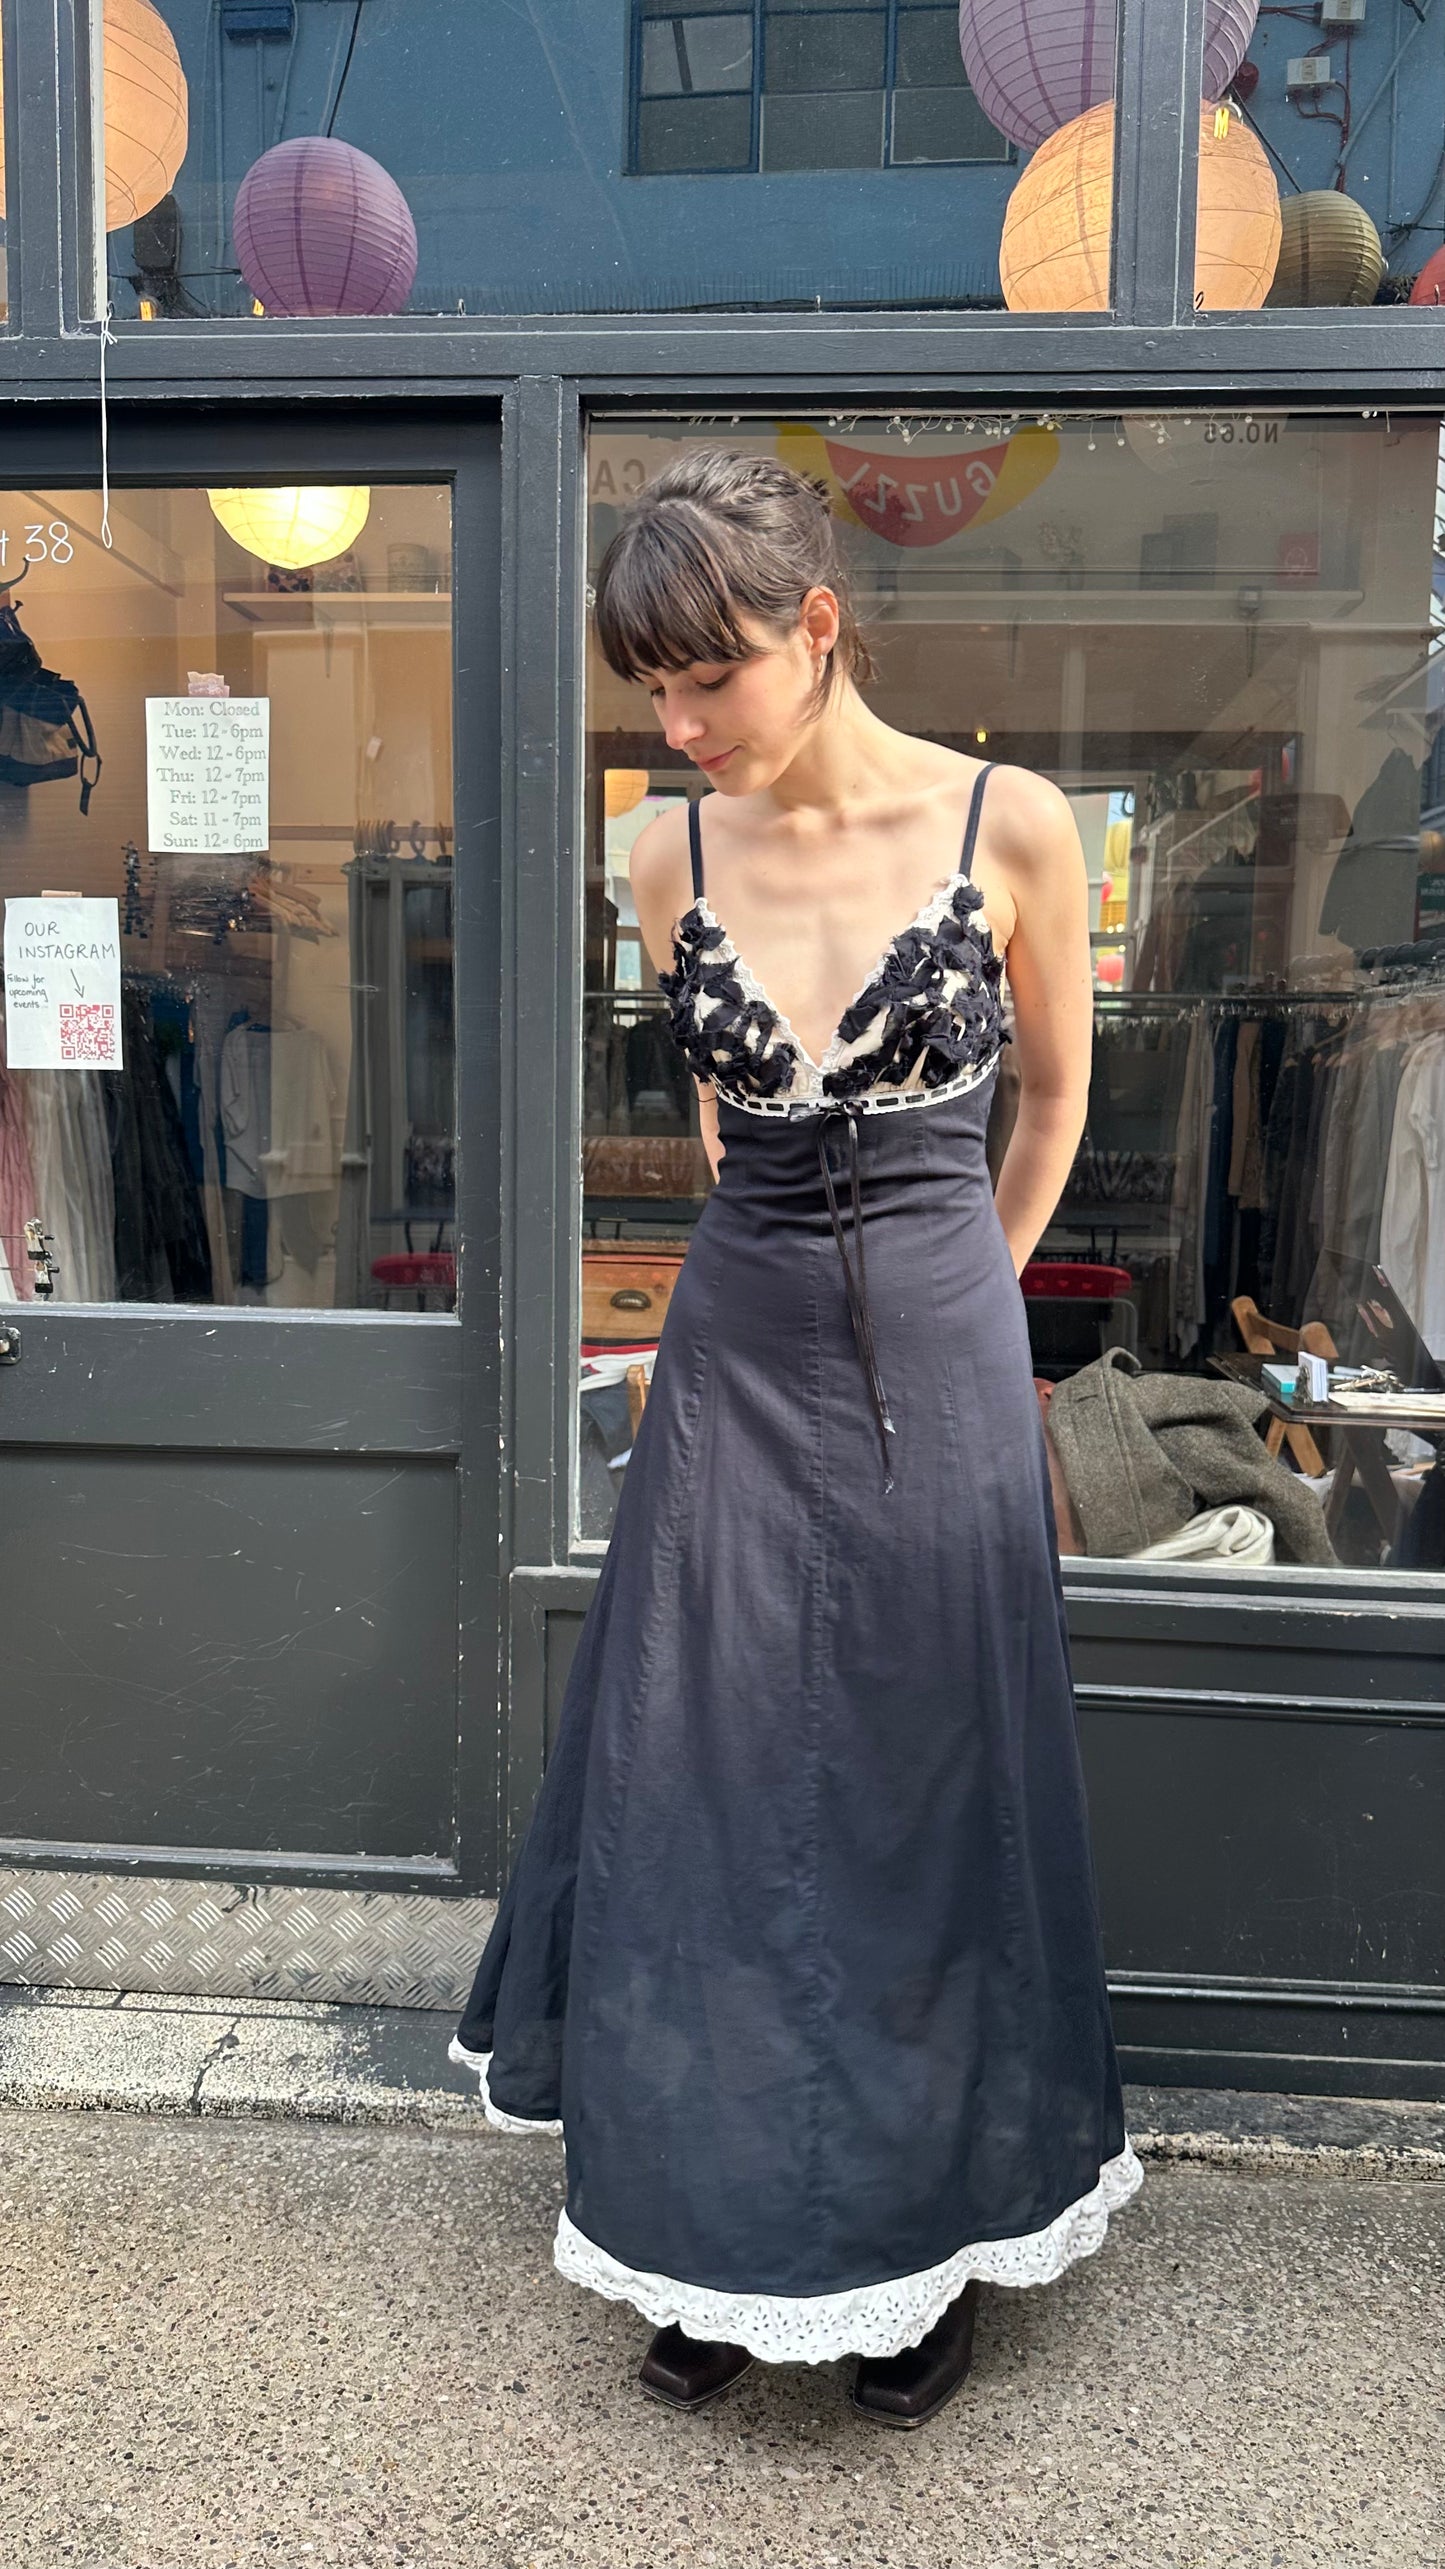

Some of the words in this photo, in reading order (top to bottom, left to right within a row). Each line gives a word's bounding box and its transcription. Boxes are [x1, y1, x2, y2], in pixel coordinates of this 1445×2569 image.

[23, 521, 74, 564] 38
[164, 702, 204, 716] Mon:
[210, 701, 260, 716] Closed
[162, 724, 196, 738] Tue:
[202, 723, 219, 738] 12
[231, 724, 263, 742] 6pm
[160, 746, 201, 760] Wed:
[207, 745, 223, 760] 12
[235, 746, 266, 764] 6pm
[156, 768, 194, 782] Thu:
[206, 767, 222, 782] 12
[235, 768, 264, 786] 7pm
[170, 790, 196, 804] Fri:
[202, 789, 218, 804] 12
[232, 791, 261, 808] 7pm
[169, 812, 197, 825] Sat:
[204, 812, 217, 826] 11
[233, 812, 261, 830] 7pm
[164, 833, 198, 847] Sun:
[204, 833, 221, 847] 12
[234, 834, 263, 851] 6pm
[24, 921, 60, 936] OUR
[19, 943, 116, 959] INSTAGRAM
[9, 989, 48, 1003] upcoming
